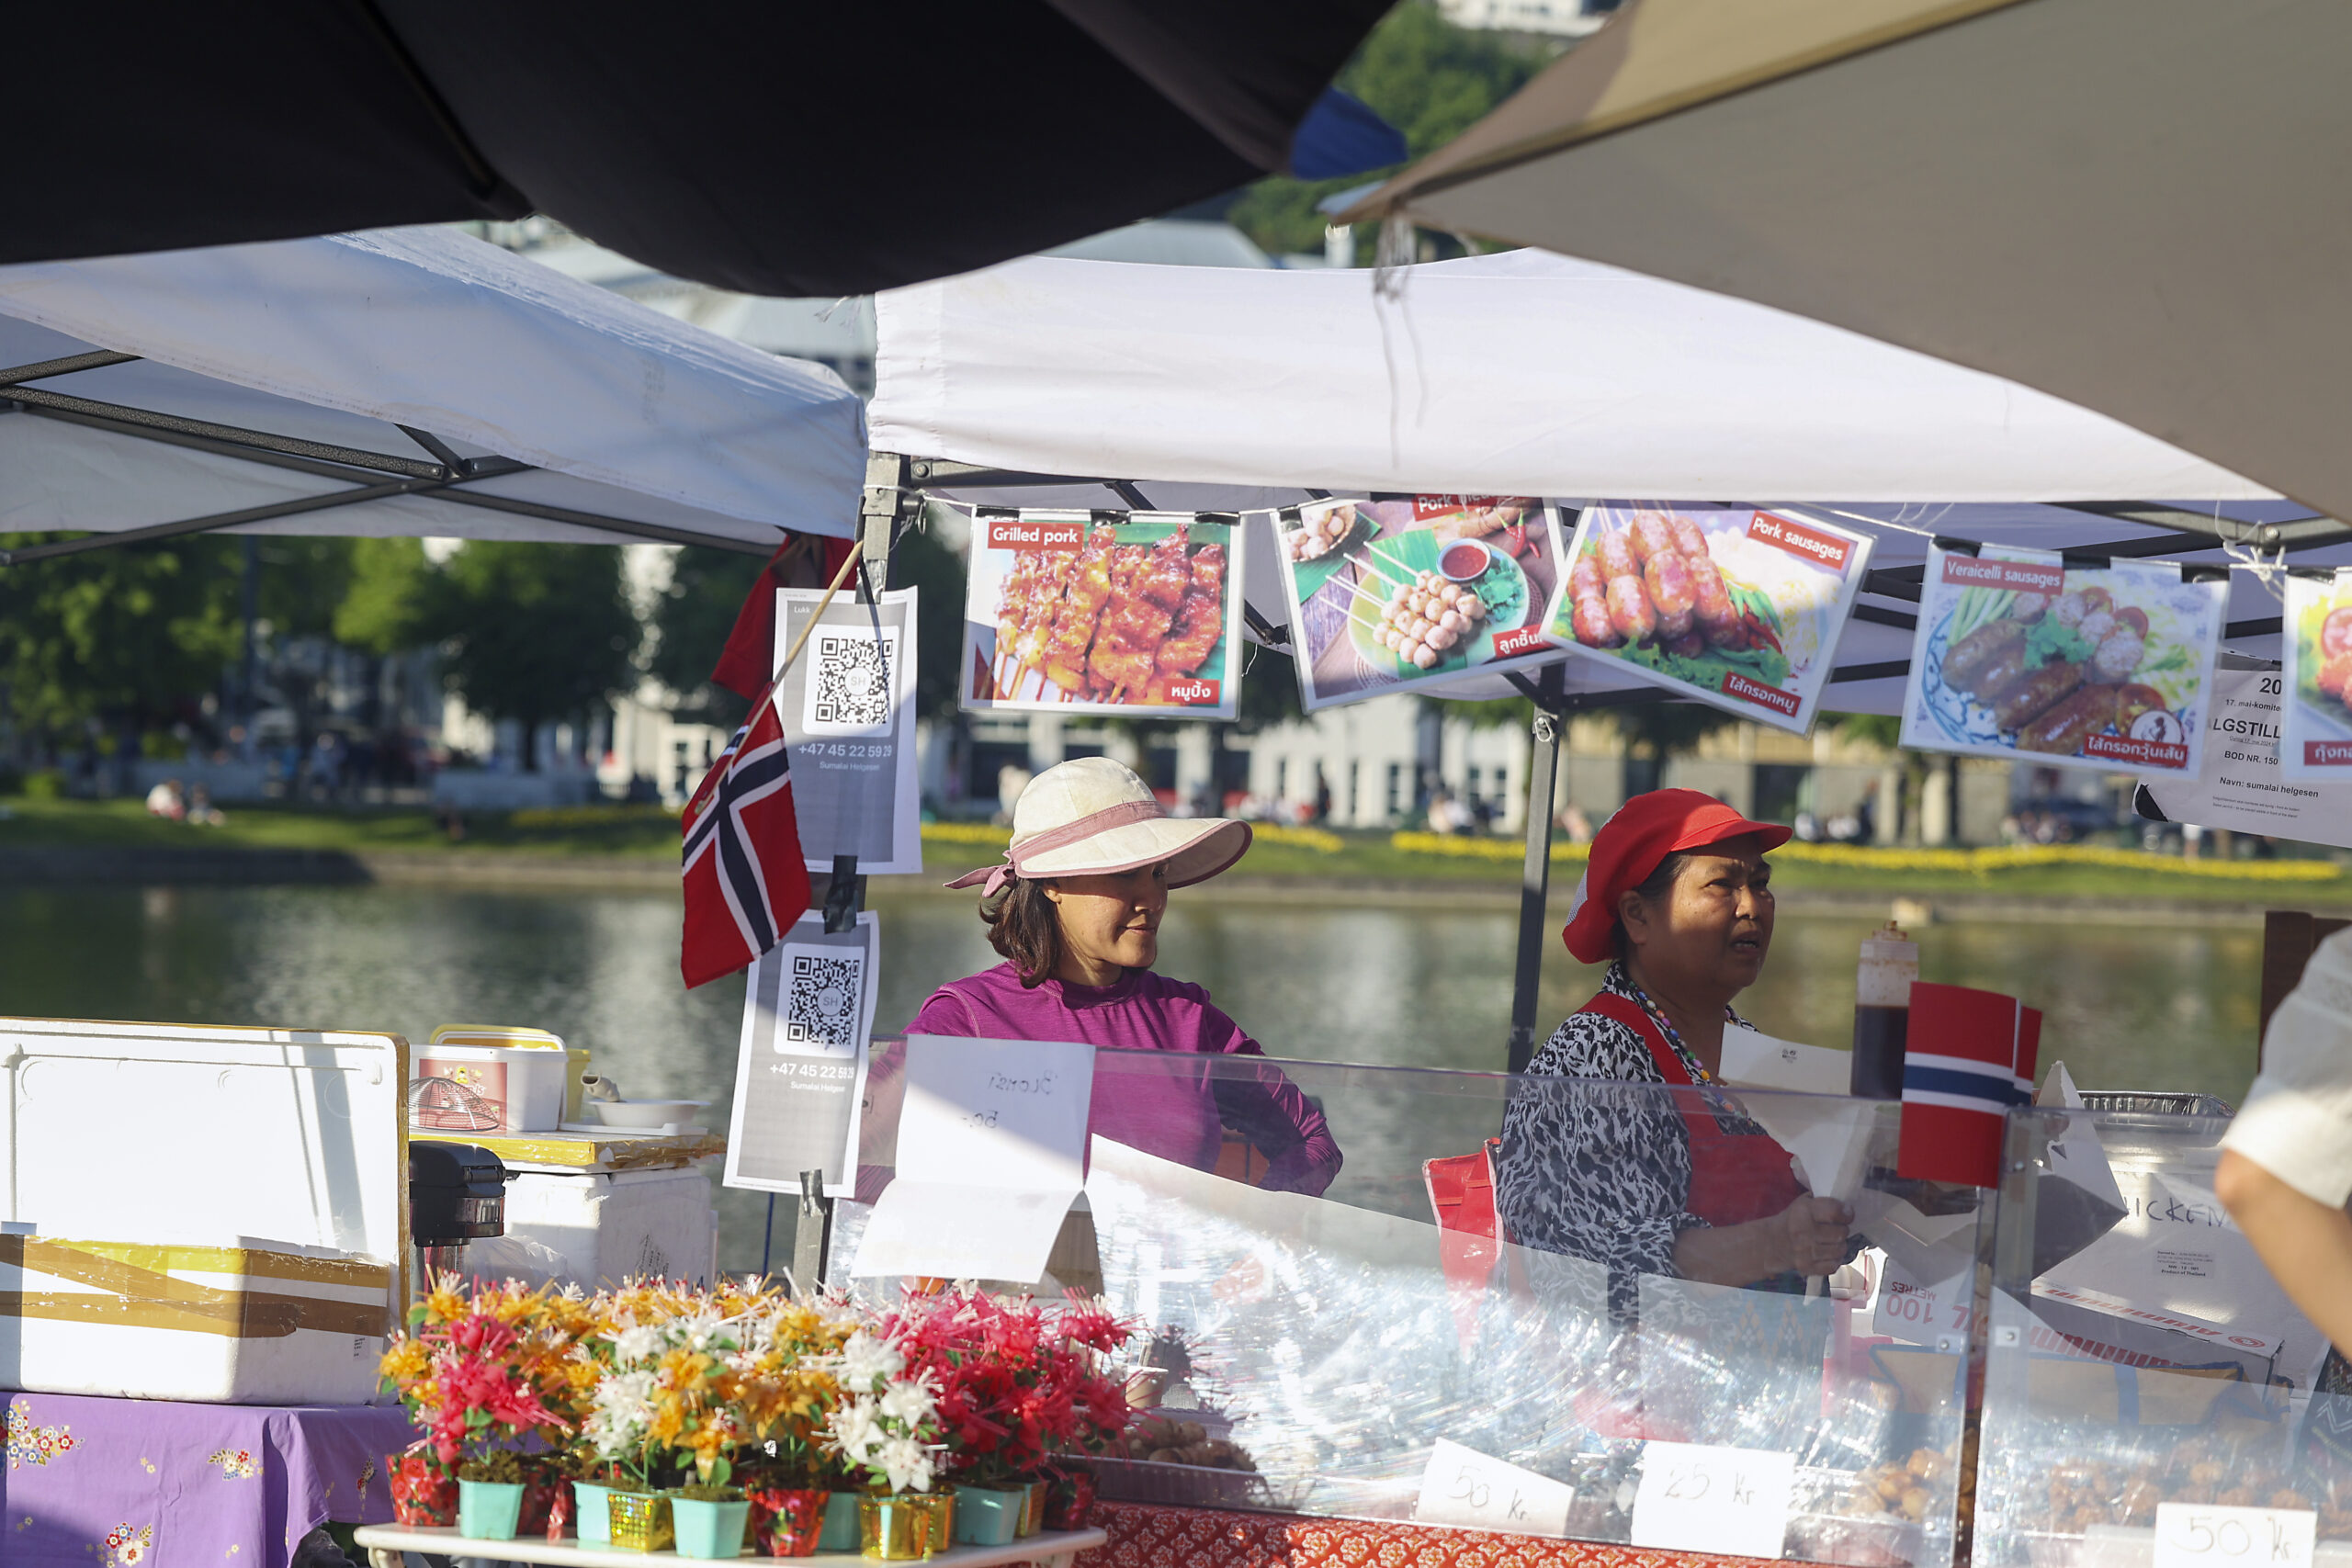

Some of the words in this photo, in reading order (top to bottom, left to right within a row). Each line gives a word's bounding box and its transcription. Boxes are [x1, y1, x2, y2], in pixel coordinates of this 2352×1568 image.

[1418, 493, 1452, 513] Pork
[992, 526, 1040, 542] Grilled
[1044, 528, 1078, 546] pork
[1752, 516, 1782, 539] Pork
[1784, 532, 1843, 560] sausages
[2005, 569, 2061, 589] sausages
[1499, 629, 1543, 654] ลูกชิ้น
[1171, 680, 1211, 702] หมูปิ้ง
[1729, 675, 1794, 714] ไส้กรอกหมู
[2238, 700, 2282, 712] mai-komite
[2212, 717, 2281, 739] LGSTILL
[798, 743, 825, 755] +47
[828, 744, 846, 756] 45
[849, 745, 865, 757] 22
[2224, 750, 2245, 761] BOD
[2264, 757, 2278, 765] 150
[2220, 776, 2245, 787] Navn:
[2246, 781, 2279, 792] sumalai
[2280, 785, 2319, 797] helgesen
[823, 997, 838, 1007] SH
[770, 1062, 797, 1076] +47
[799, 1064, 818, 1077] 45
[820, 1066, 836, 1078] 22
[1892, 1281, 1937, 1301] METRES
[1886, 1294, 1934, 1324] 100
[1447, 1465, 1490, 1508] 50
[2170, 1517, 2250, 1556] 50
